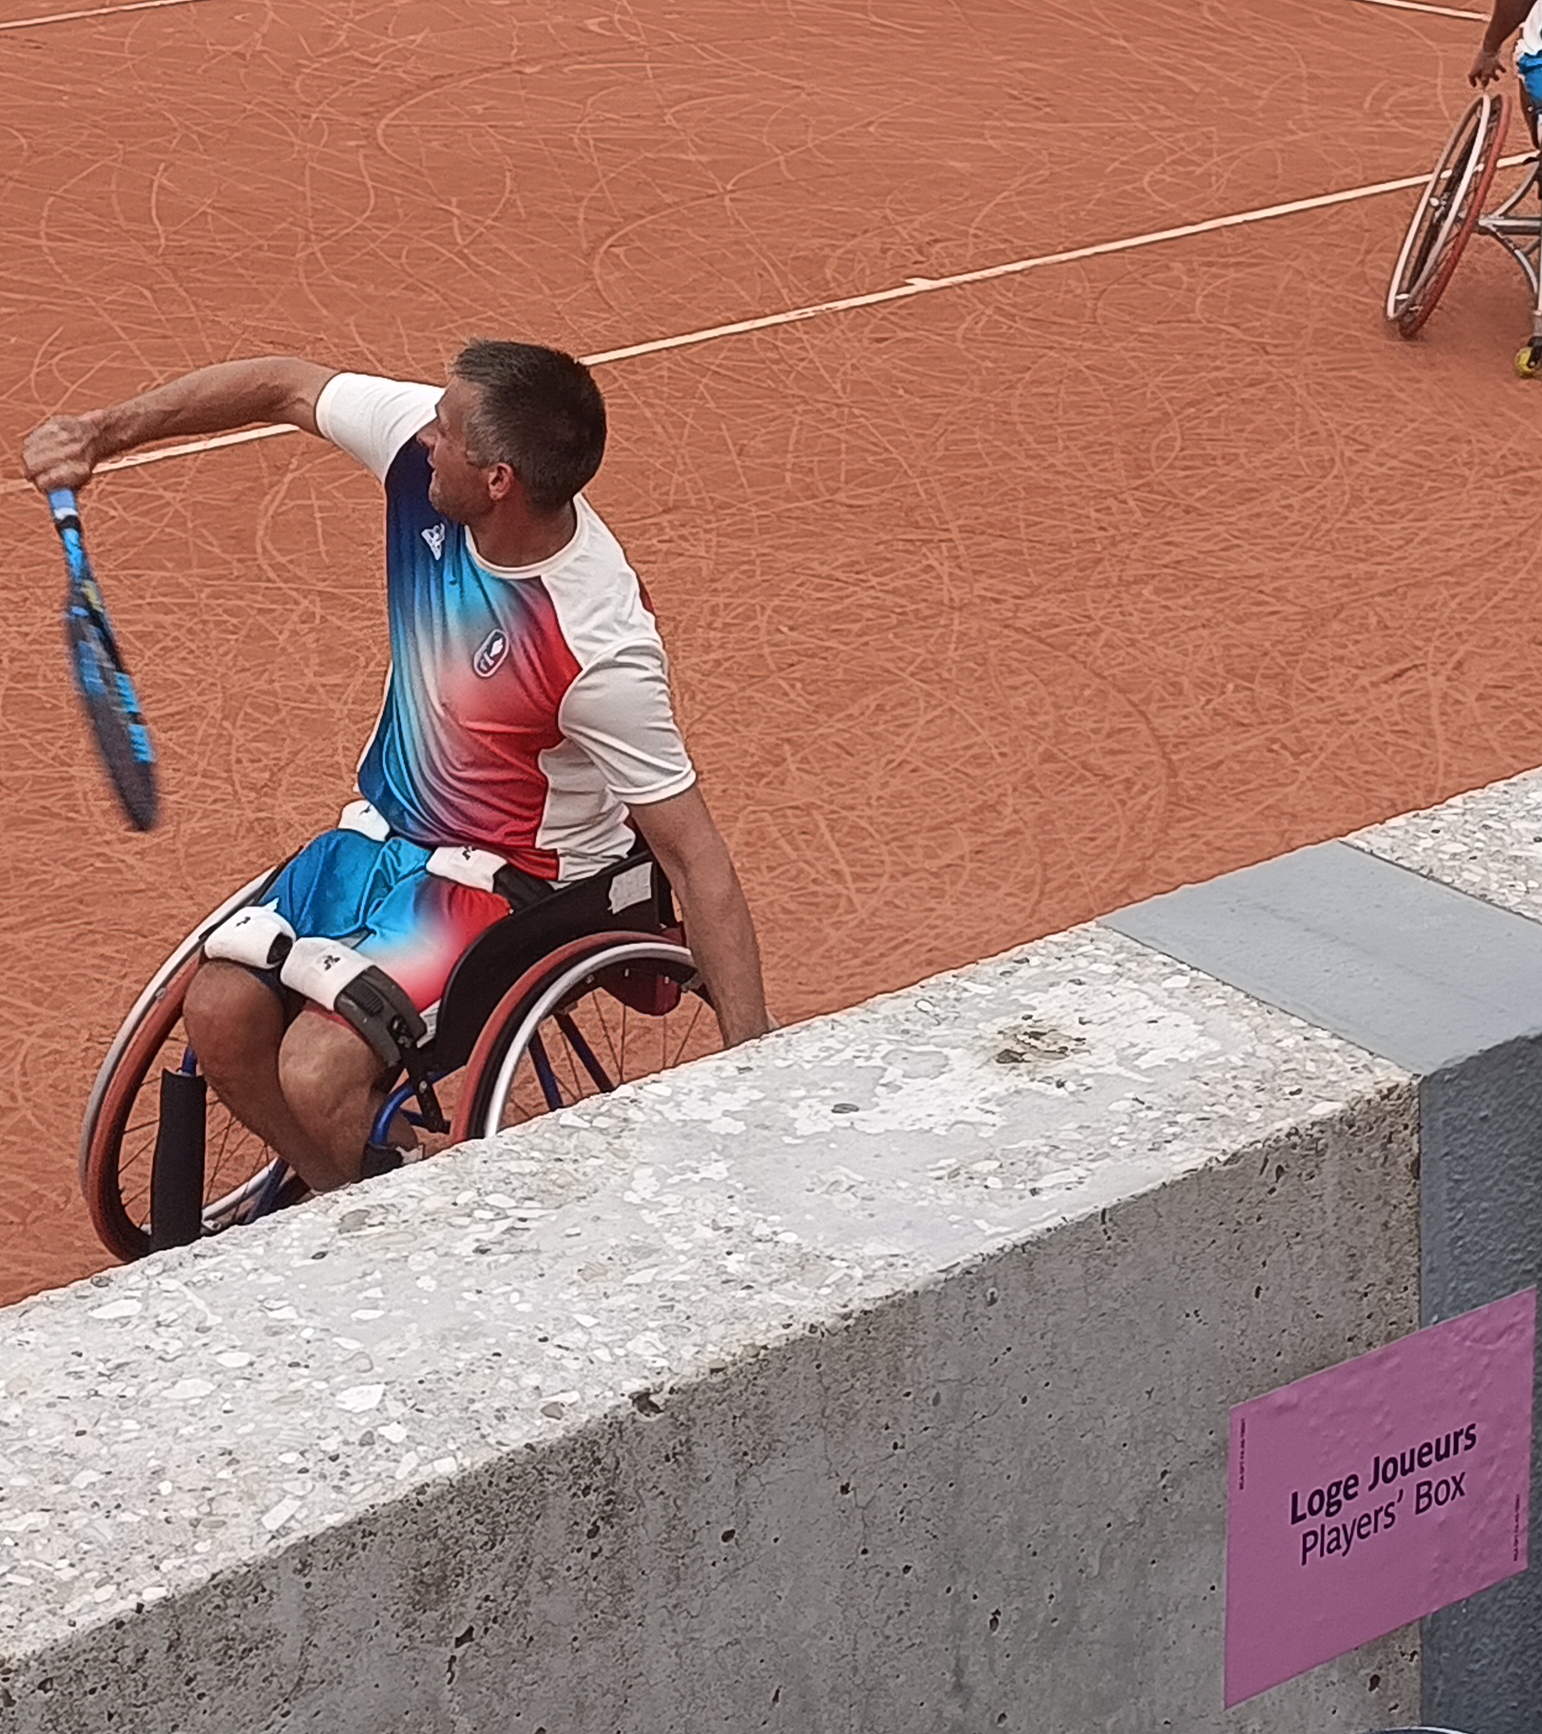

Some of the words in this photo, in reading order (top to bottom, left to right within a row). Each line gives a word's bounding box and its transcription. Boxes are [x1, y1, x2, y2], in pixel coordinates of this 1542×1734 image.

[1290, 1473, 1359, 1526] Loge
[1368, 1422, 1477, 1493] Joueurs
[1414, 1471, 1466, 1515] Box
